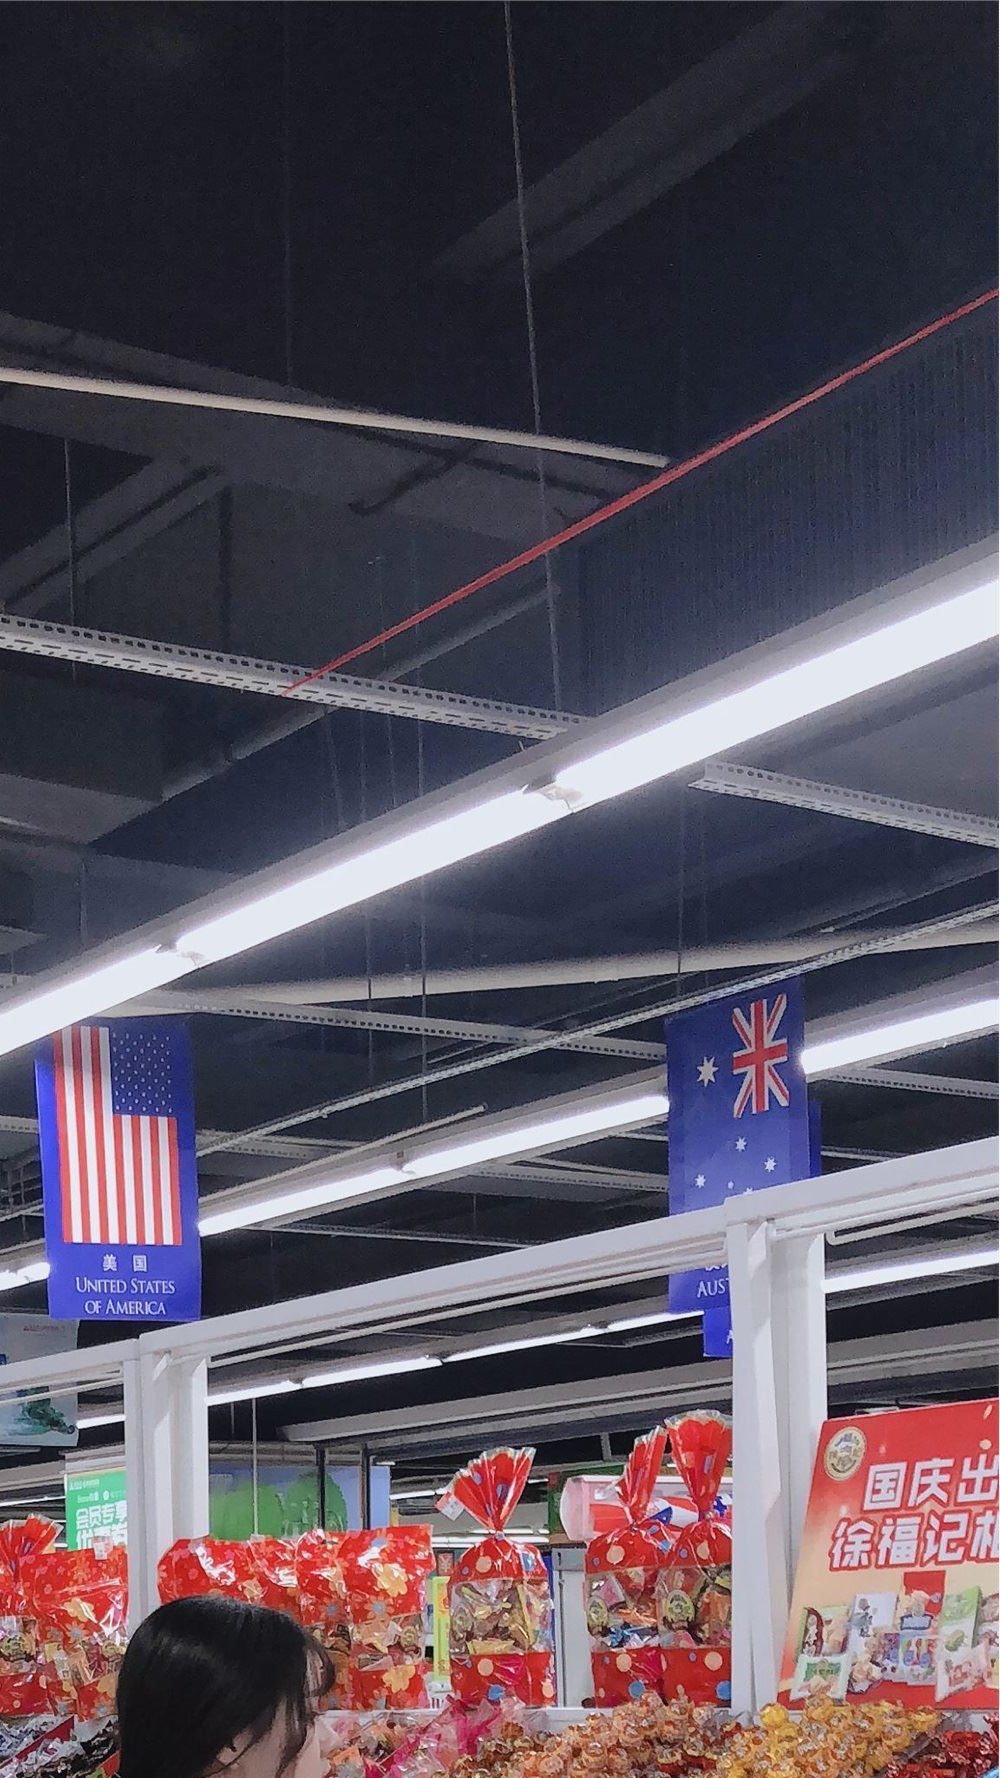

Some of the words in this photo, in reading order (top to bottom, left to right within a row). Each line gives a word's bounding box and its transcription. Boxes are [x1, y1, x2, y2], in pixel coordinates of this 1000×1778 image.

[103, 1254, 147, 1272] 美国
[76, 1277, 127, 1293] UNITED
[130, 1278, 176, 1294] STATES
[85, 1300, 101, 1314] OF
[105, 1299, 166, 1315] AMERICA
